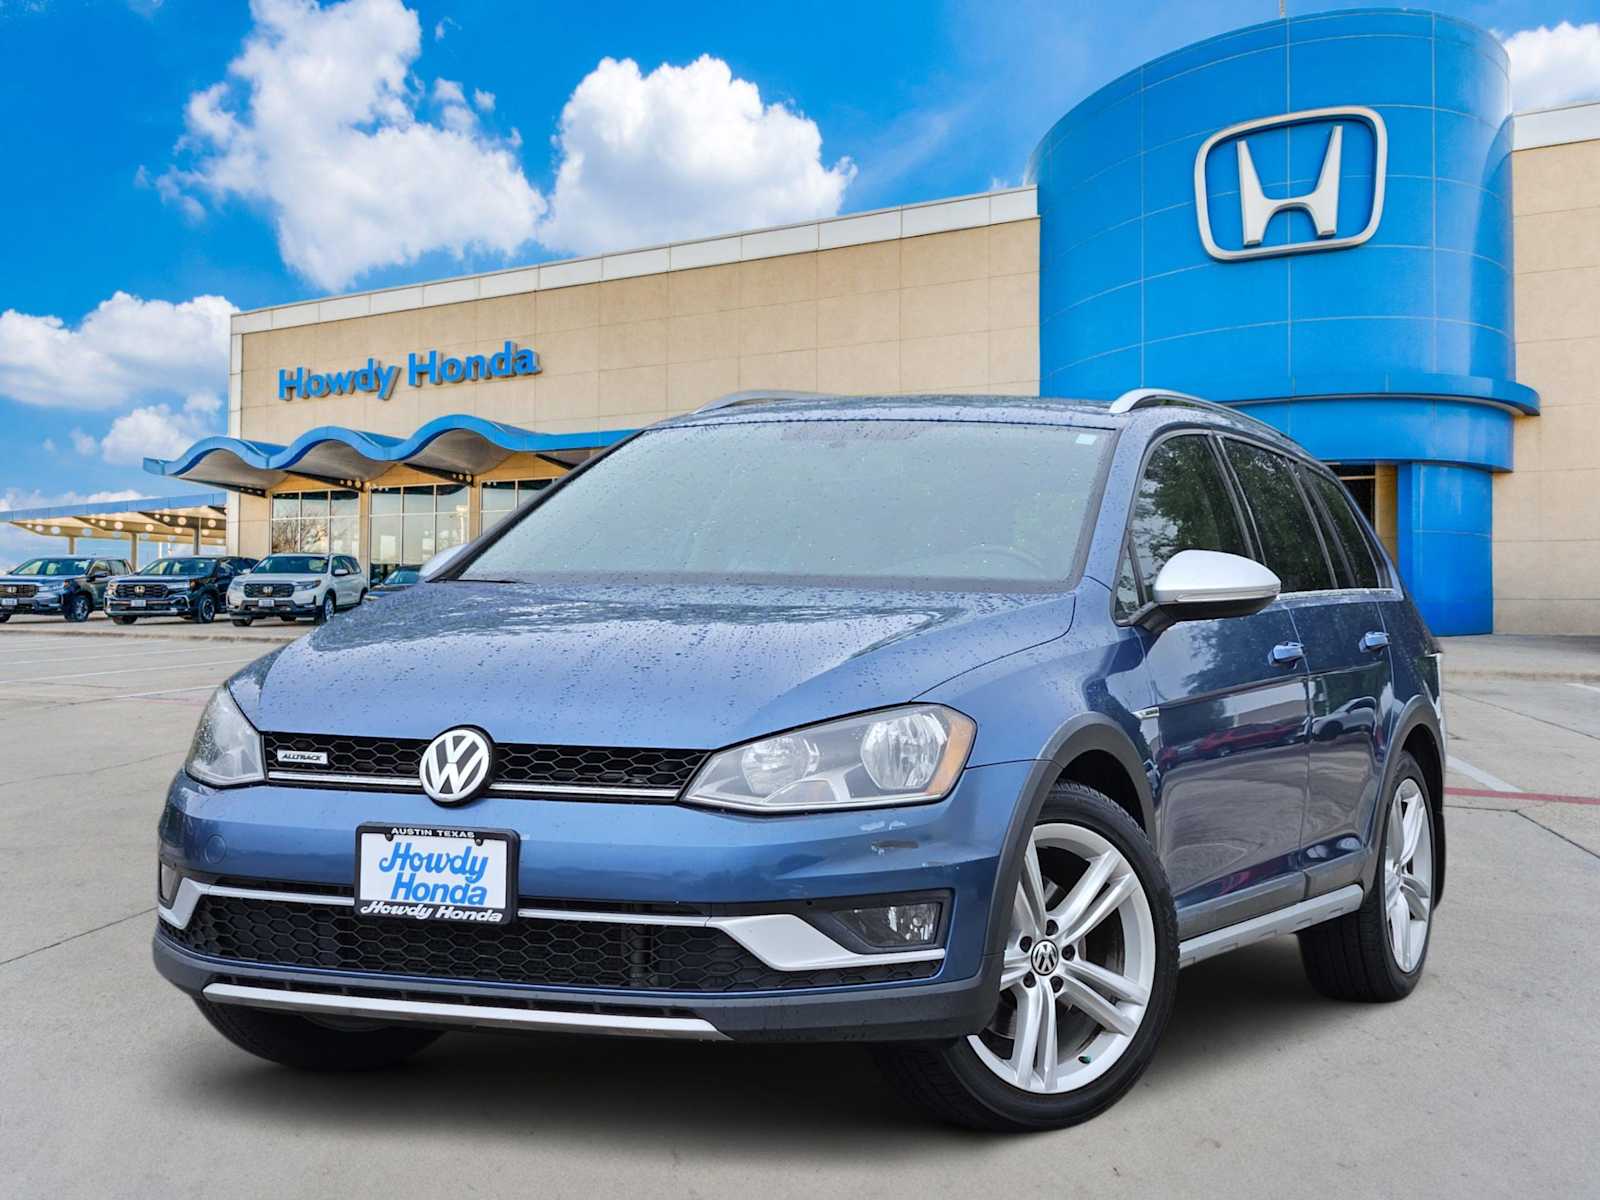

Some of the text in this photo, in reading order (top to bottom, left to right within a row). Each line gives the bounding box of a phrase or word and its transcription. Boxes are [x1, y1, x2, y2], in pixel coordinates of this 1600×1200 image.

[278, 340, 541, 400] Howdy Honda
[282, 753, 322, 761] ALLTRACK
[391, 827, 476, 838] AUSTIN TEXAS
[378, 841, 489, 884] Howdy
[390, 872, 488, 906] Honda
[360, 900, 504, 922] Howdy Honda
